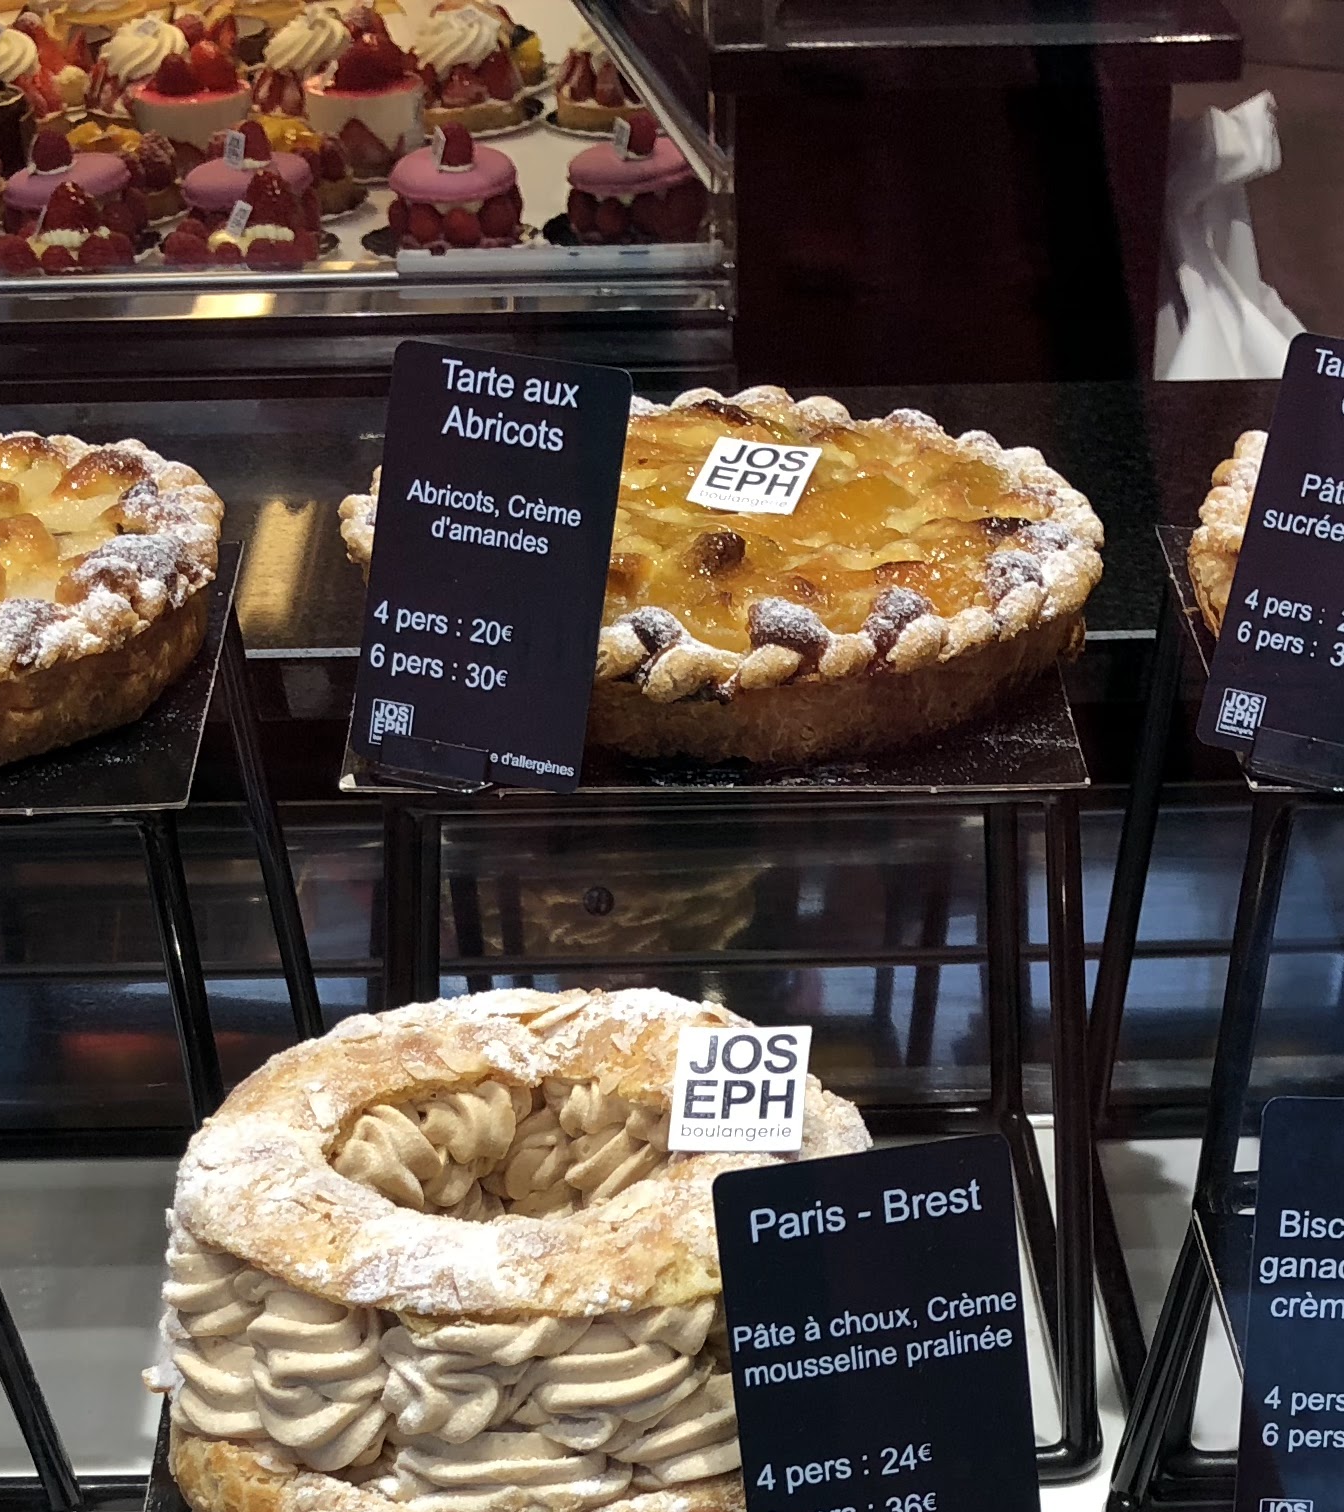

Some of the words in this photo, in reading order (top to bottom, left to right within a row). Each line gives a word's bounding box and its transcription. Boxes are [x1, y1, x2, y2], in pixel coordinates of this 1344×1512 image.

[442, 359, 514, 398] Tarte
[524, 378, 579, 408] aux
[442, 406, 563, 451] Abricots
[719, 444, 809, 472] JOS
[705, 465, 800, 497] EPH
[407, 479, 499, 517] Abricots,
[509, 495, 581, 526] Crème
[432, 516, 548, 554] d'amandes
[374, 601, 388, 624] 4
[396, 609, 448, 634] pers
[470, 619, 513, 645] 20€
[1245, 589, 1258, 610] 4
[1263, 595, 1312, 624] pers
[1236, 621, 1252, 643] 6
[1255, 627, 1305, 657] pers
[369, 644, 385, 668] 6
[391, 653, 443, 678] pers
[465, 663, 508, 690] 30€
[501, 752, 575, 777] d'allergènes
[689, 1033, 798, 1075] JOS
[683, 1079, 795, 1120] EPH
[681, 1124, 792, 1142] boulangerie
[750, 1201, 846, 1243] Paris
[884, 1179, 982, 1223] Brest
[734, 1323, 795, 1352] Pâte
[805, 1316, 821, 1341] à
[830, 1308, 917, 1336] choux,
[928, 1292, 1016, 1321] Crème
[745, 1345, 897, 1386] mousseline
[907, 1325, 1012, 1367] pralinée
[1264, 1386, 1281, 1409] 4
[1262, 1423, 1279, 1446] 6
[757, 1464, 776, 1490] 4
[786, 1458, 851, 1494] pers
[881, 1444, 932, 1475] 24€
